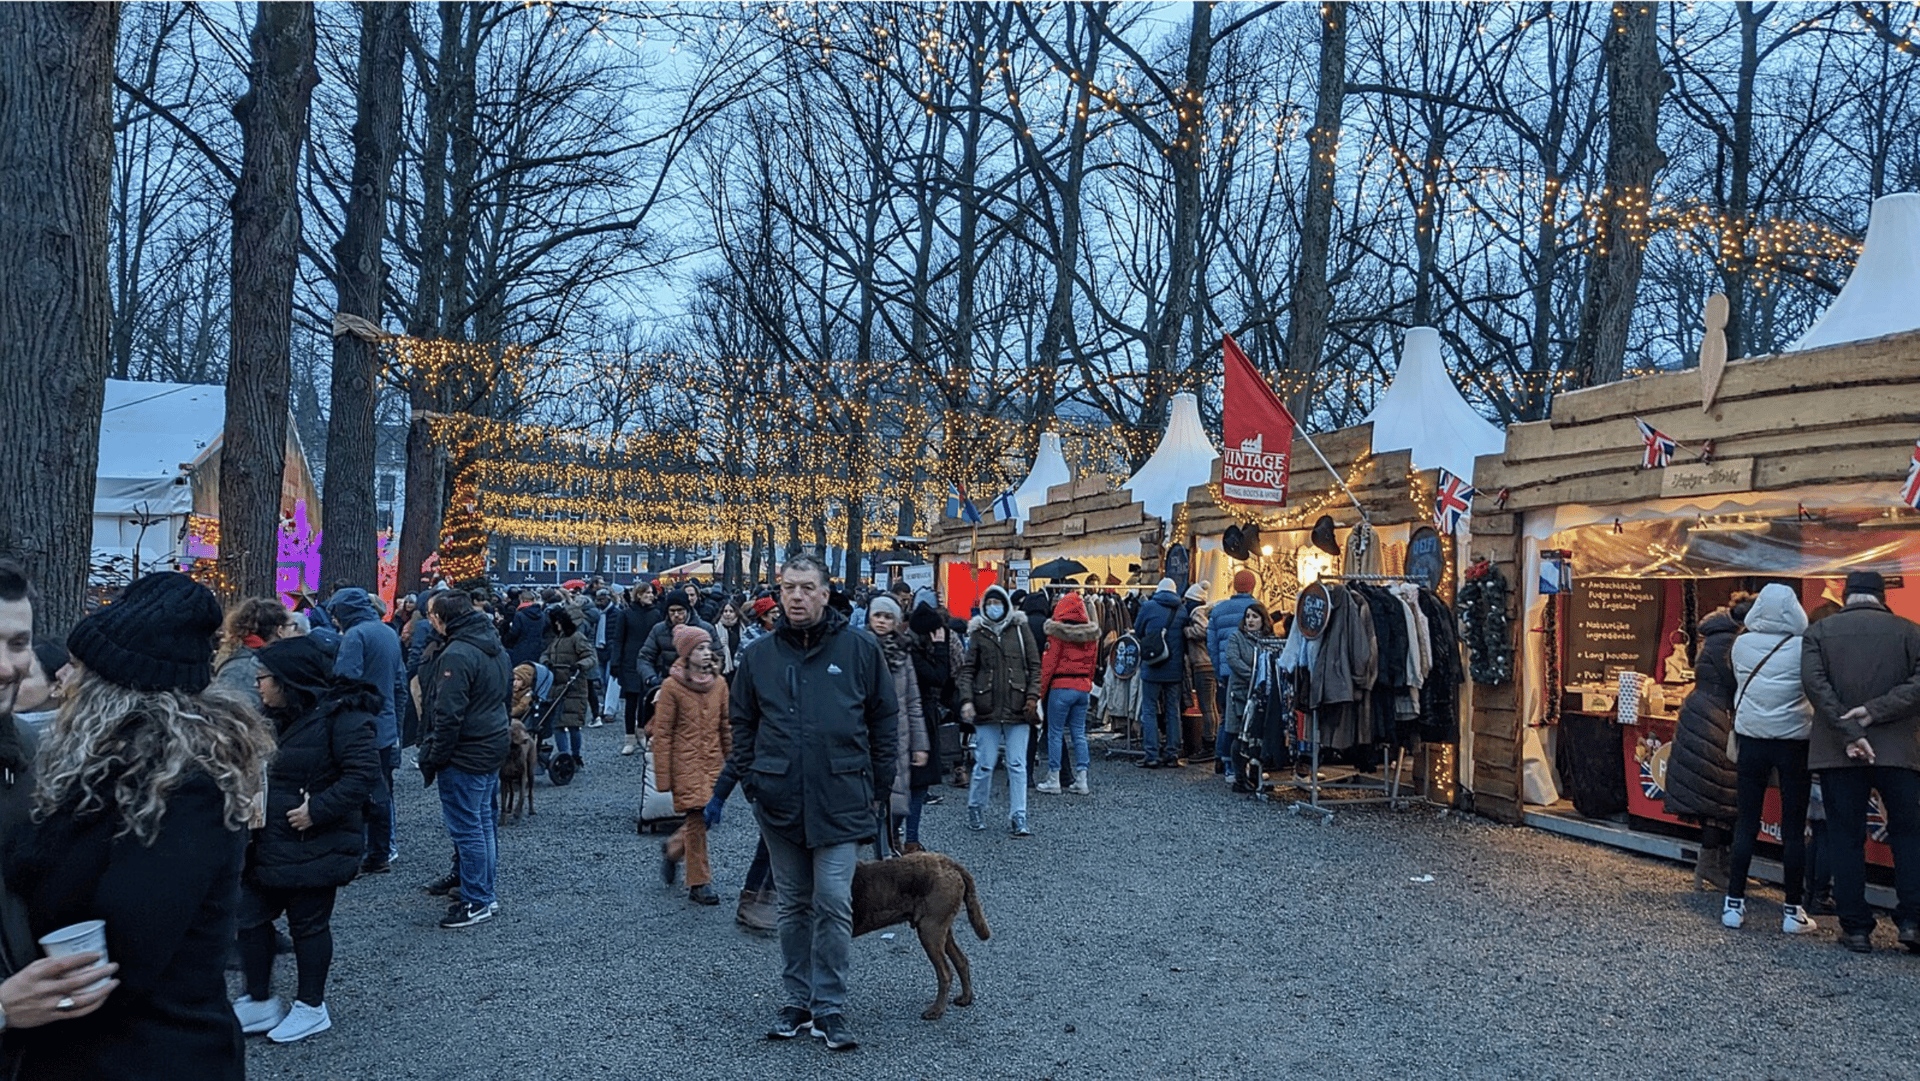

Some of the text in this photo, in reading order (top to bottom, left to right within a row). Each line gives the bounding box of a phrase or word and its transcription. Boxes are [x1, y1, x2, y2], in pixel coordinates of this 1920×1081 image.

[1224, 450, 1285, 470] VINTAGE
[1224, 465, 1285, 489] FACTORY
[1588, 581, 1641, 591] Ambachtelijke
[1588, 591, 1611, 601] Fudge
[1584, 651, 1604, 662] Lang
